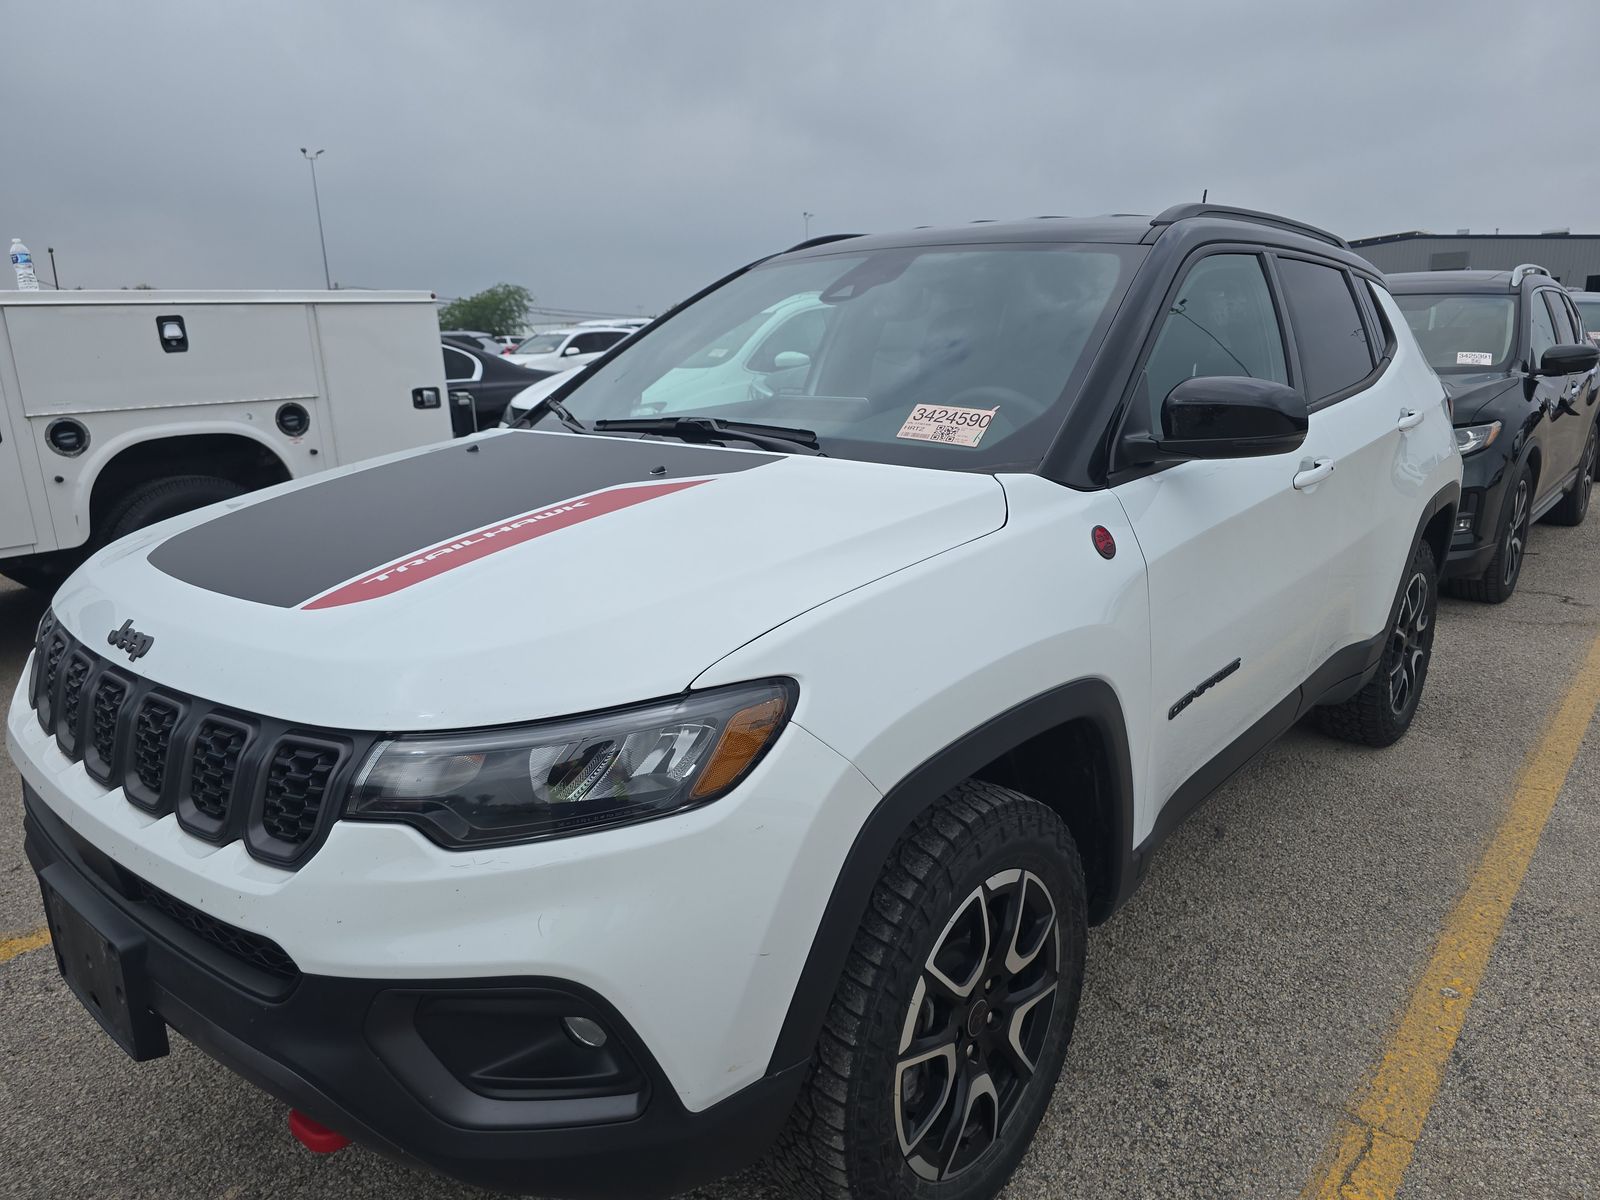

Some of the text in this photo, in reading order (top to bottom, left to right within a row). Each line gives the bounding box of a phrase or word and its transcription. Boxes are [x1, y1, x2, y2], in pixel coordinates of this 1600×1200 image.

[913, 407, 992, 429] 3424590
[362, 500, 591, 585] TRAILHAWK
[107, 618, 155, 663] Jeep
